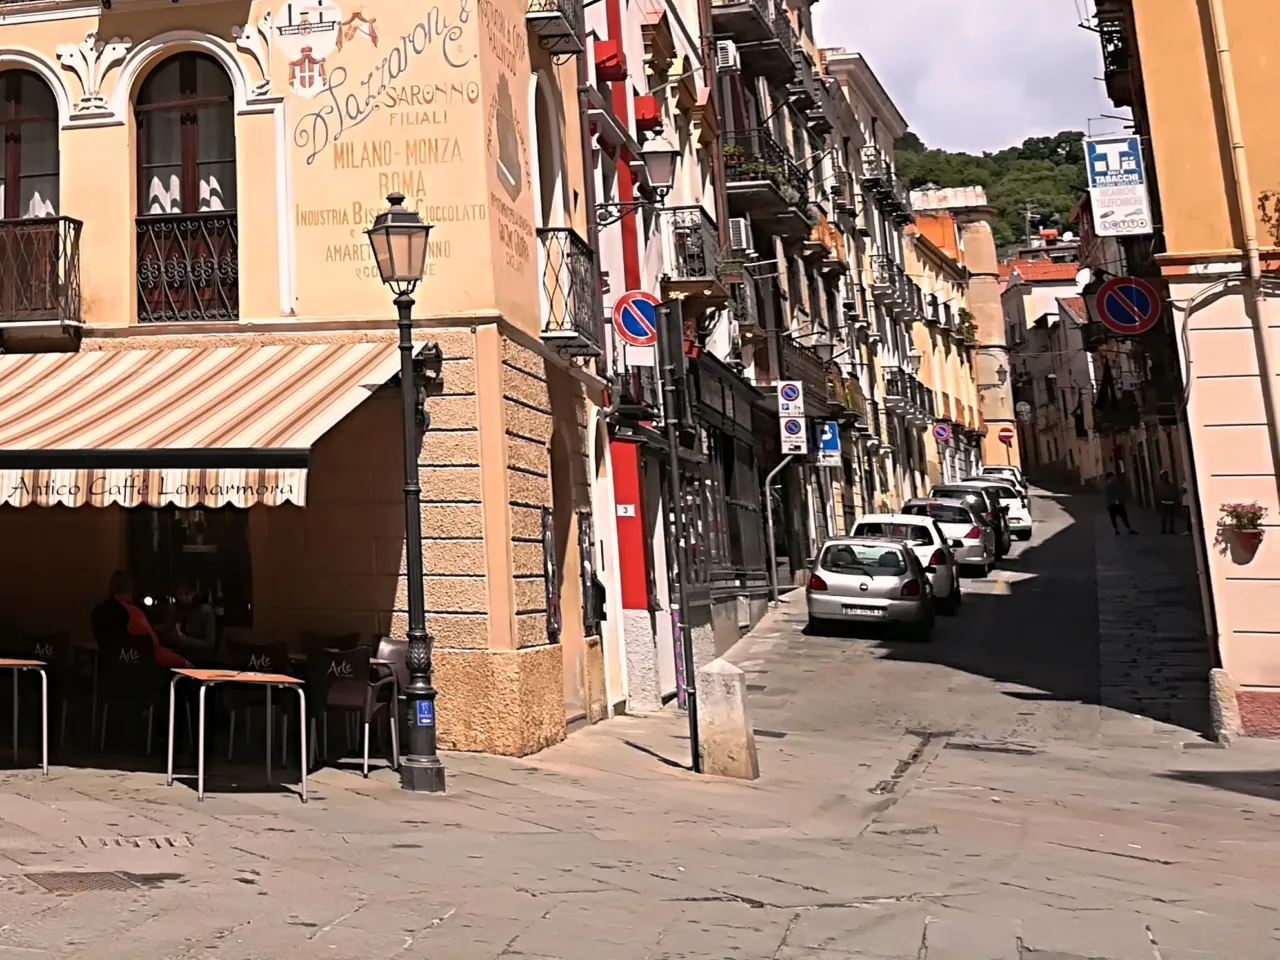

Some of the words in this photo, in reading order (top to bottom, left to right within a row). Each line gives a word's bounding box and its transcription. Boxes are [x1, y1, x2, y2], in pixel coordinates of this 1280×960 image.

[377, 80, 480, 109] SARONNO
[389, 111, 448, 126] FILIALI
[333, 140, 392, 170] MILANO
[405, 137, 463, 165] MONZA
[378, 170, 427, 199] ROMA
[1094, 173, 1139, 184] TABACCHI
[7, 475, 81, 499] Antico
[158, 476, 294, 496] Lamarmora
[622, 506, 629, 515] 3
[118, 647, 140, 664] Arte
[248, 653, 272, 670] Arte
[326, 659, 353, 677] Arte
